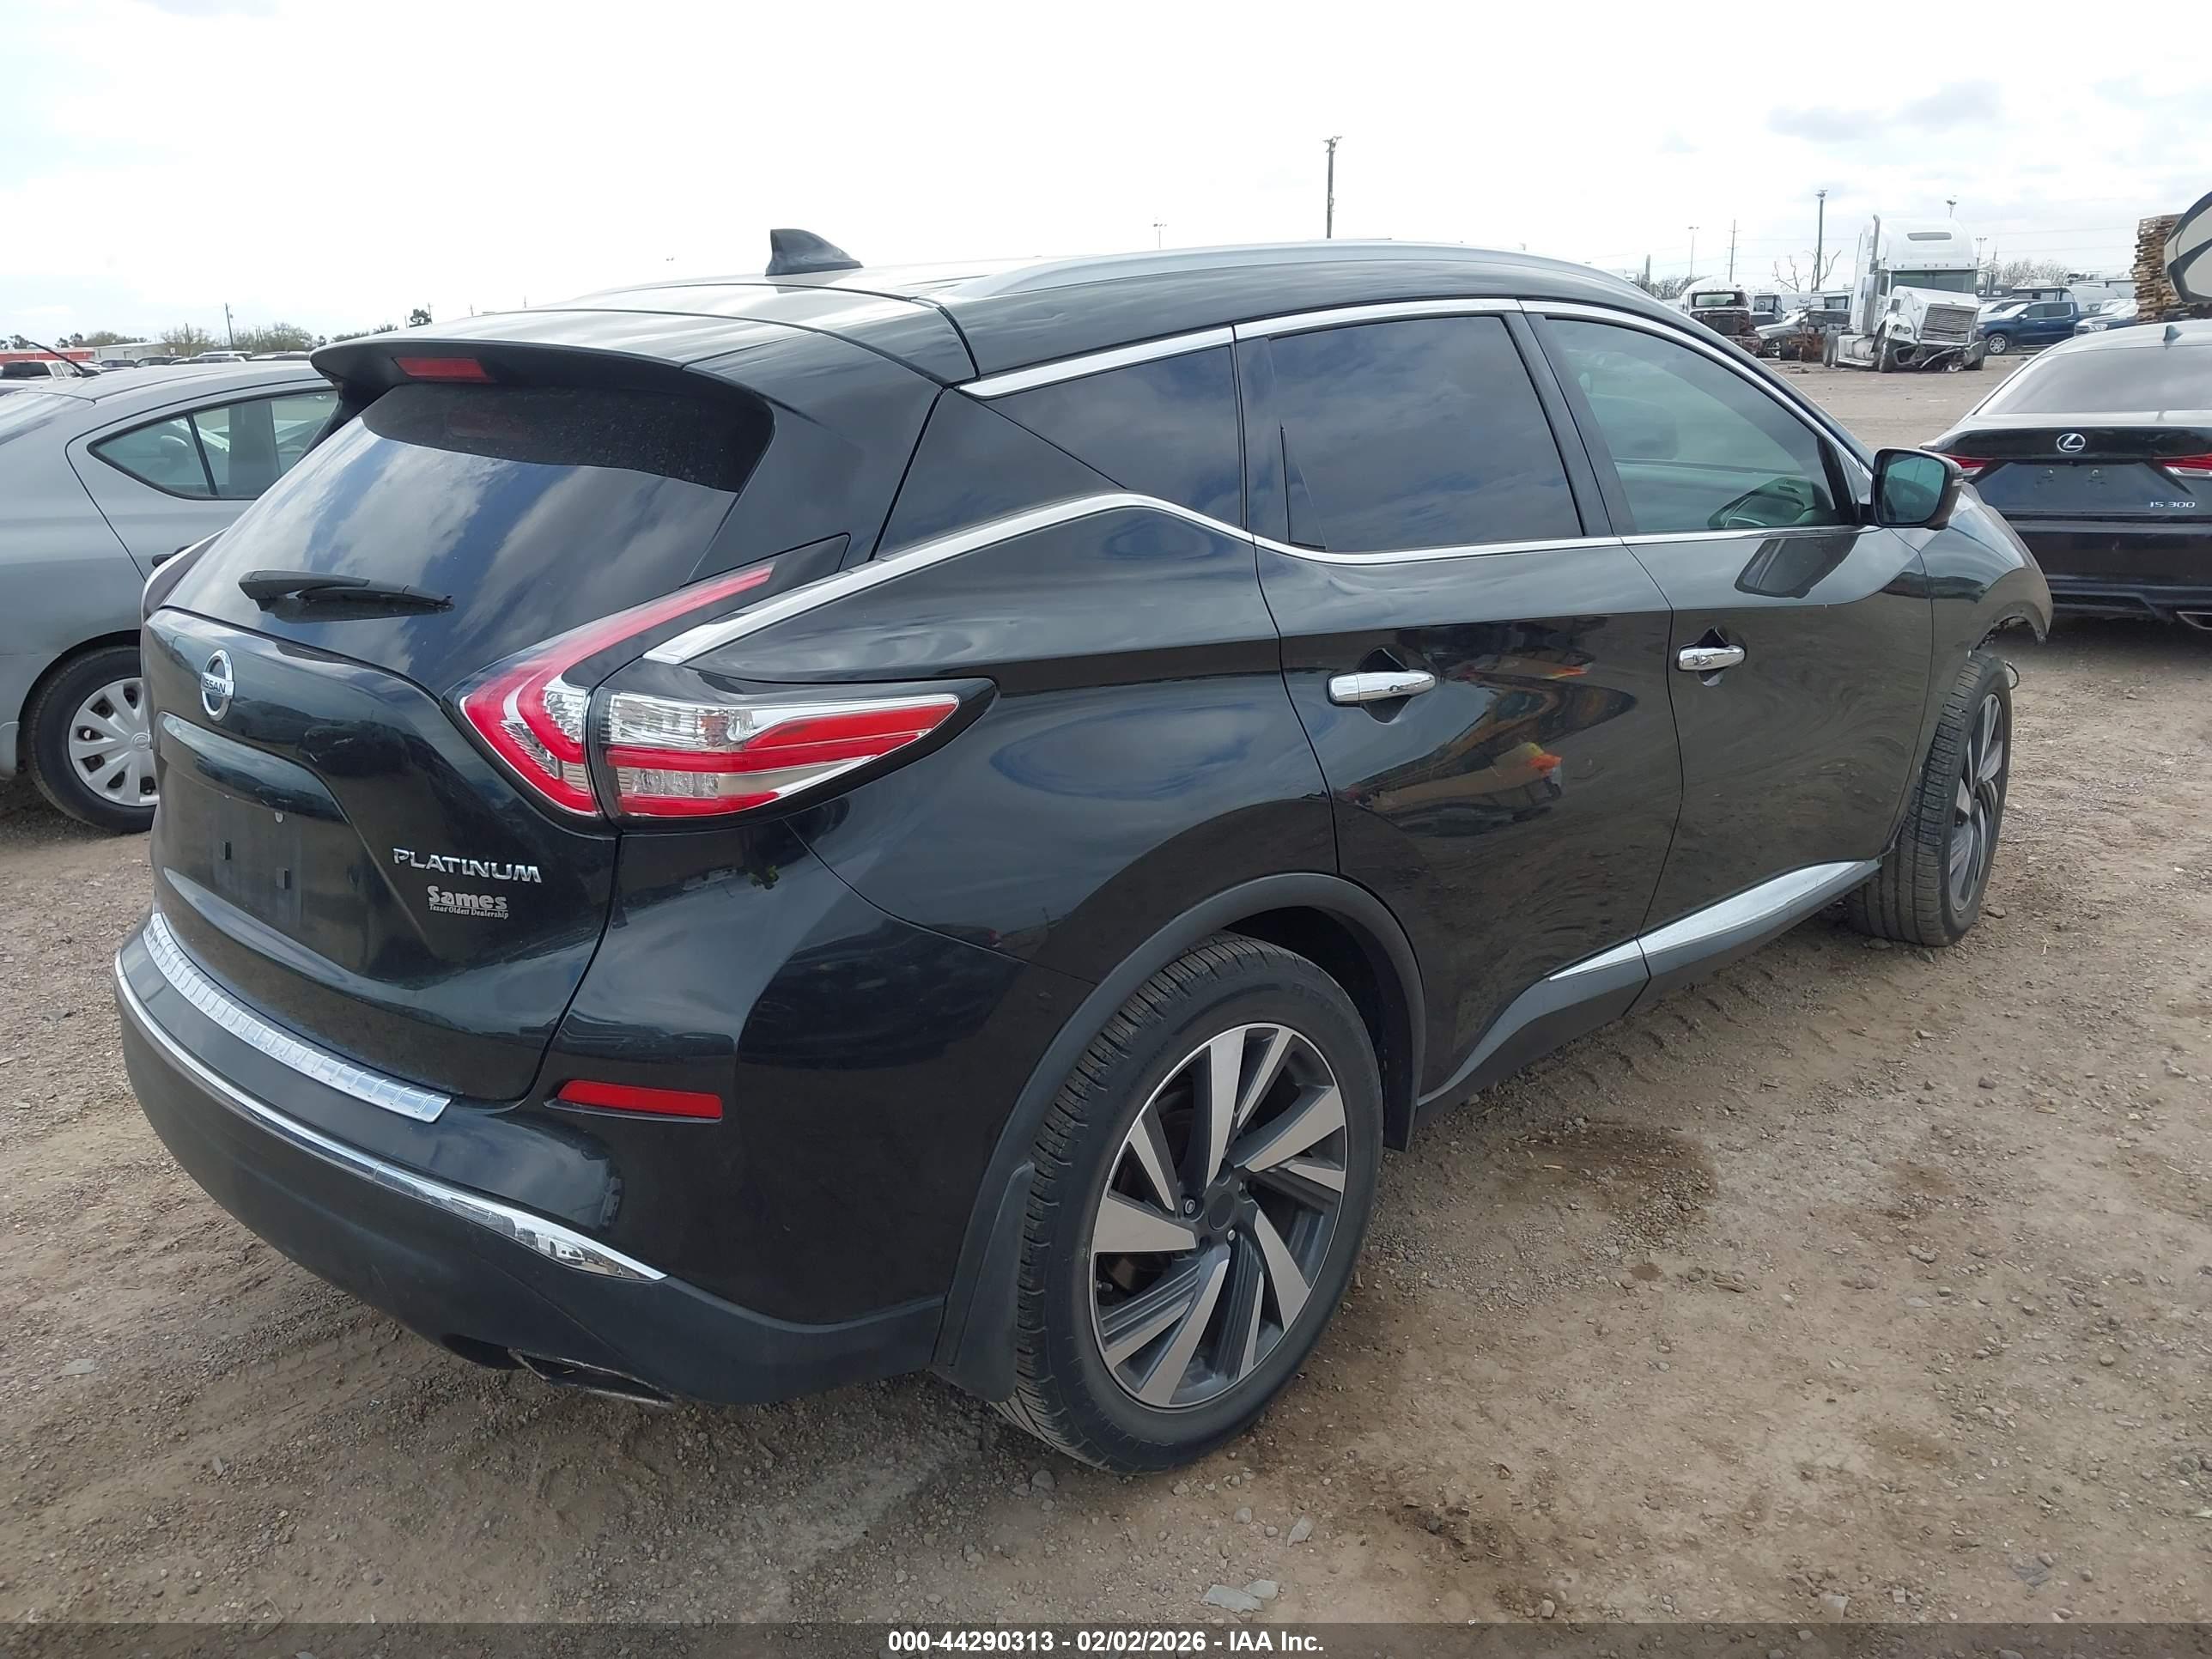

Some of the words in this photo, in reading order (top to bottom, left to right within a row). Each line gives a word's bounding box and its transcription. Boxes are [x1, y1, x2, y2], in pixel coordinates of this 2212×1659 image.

[392, 847, 543, 884] PLATINUM
[427, 885, 508, 910] Sames
[471, 908, 509, 920] Dealership
